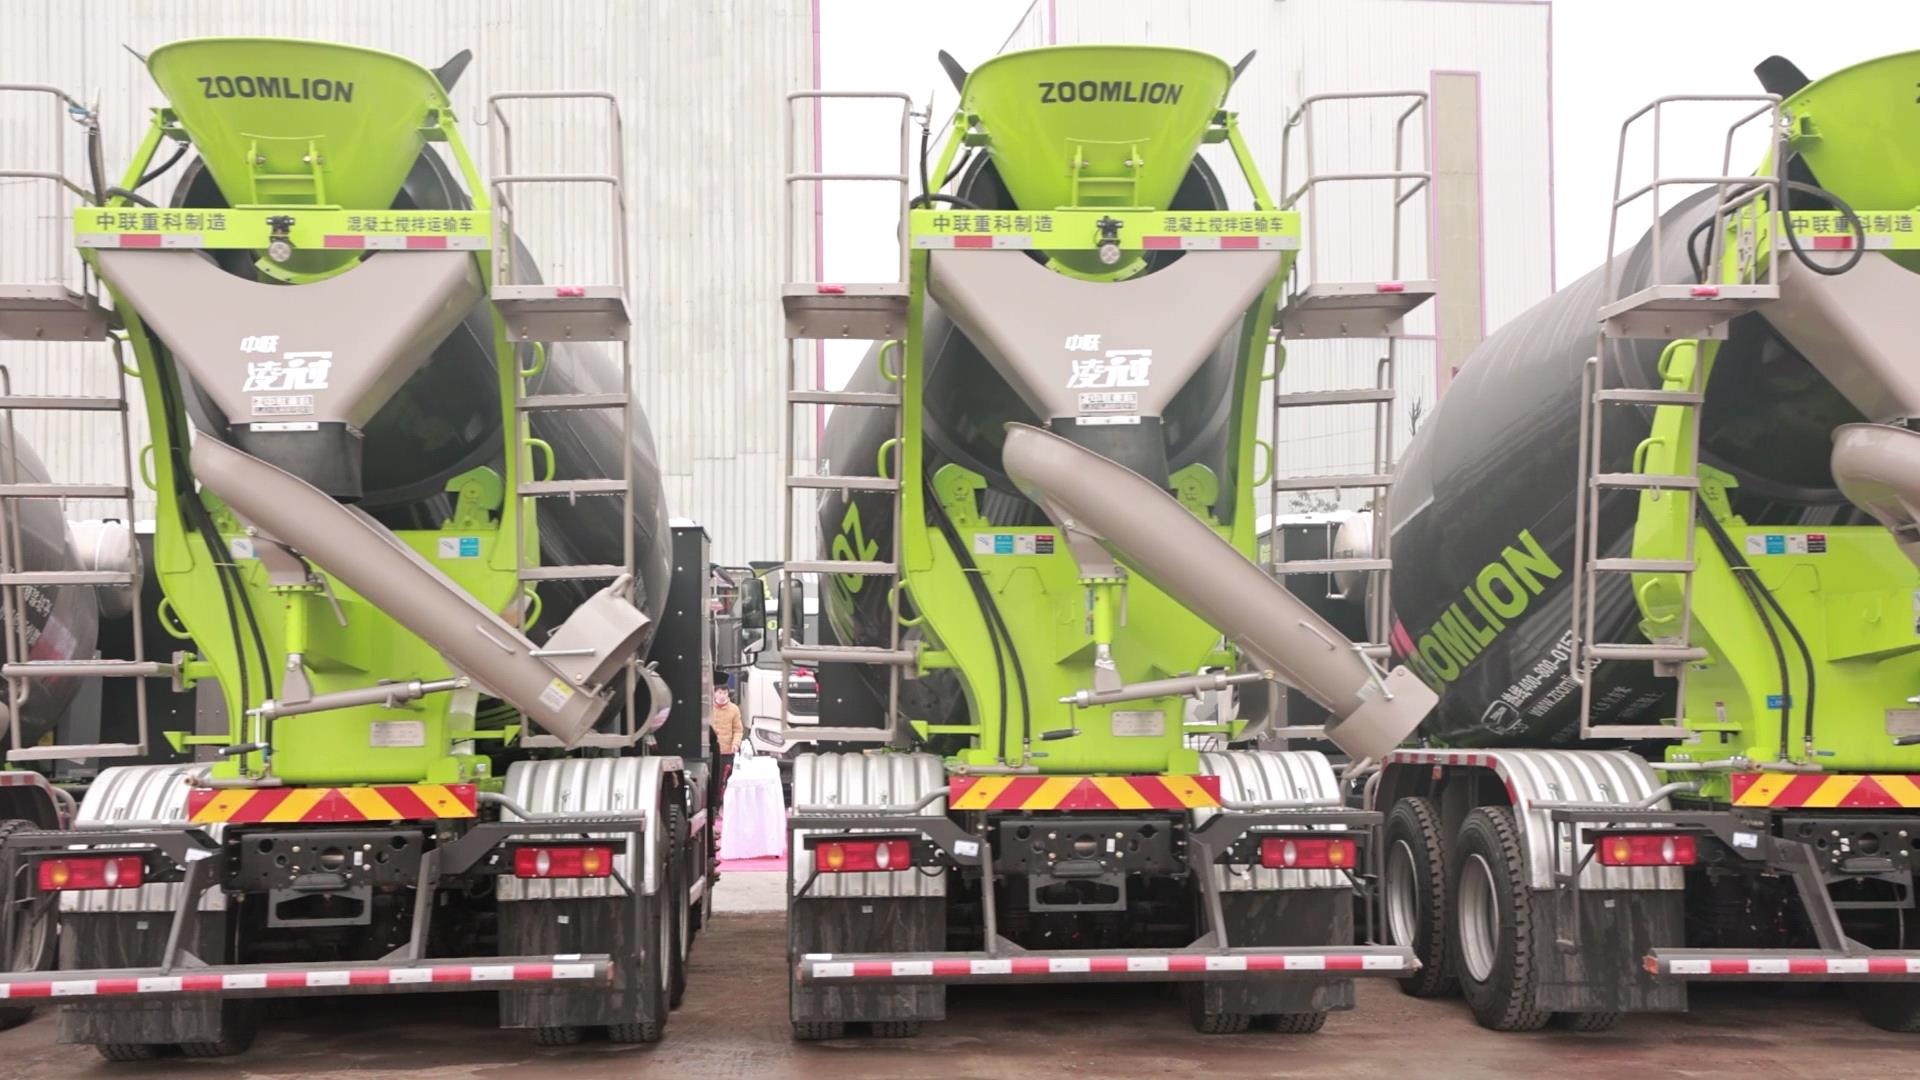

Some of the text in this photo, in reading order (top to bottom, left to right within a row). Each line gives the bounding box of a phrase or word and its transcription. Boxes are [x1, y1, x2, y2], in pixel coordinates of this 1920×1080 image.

[197, 76, 353, 103] ZOOMLION
[1038, 81, 1184, 104] ZOOMLION
[97, 212, 226, 231] 中联重科制造
[347, 216, 473, 232] 混凝土搅拌运输车
[933, 214, 1053, 232] 中联重科制造
[1162, 217, 1284, 232] 混凝土搅拌运输车
[240, 335, 280, 353] 中联
[1064, 334, 1102, 351] 中联
[242, 351, 333, 392] 凌冠
[1066, 349, 1152, 388] 凌冠
[1403, 528, 1563, 698] OOMLION
